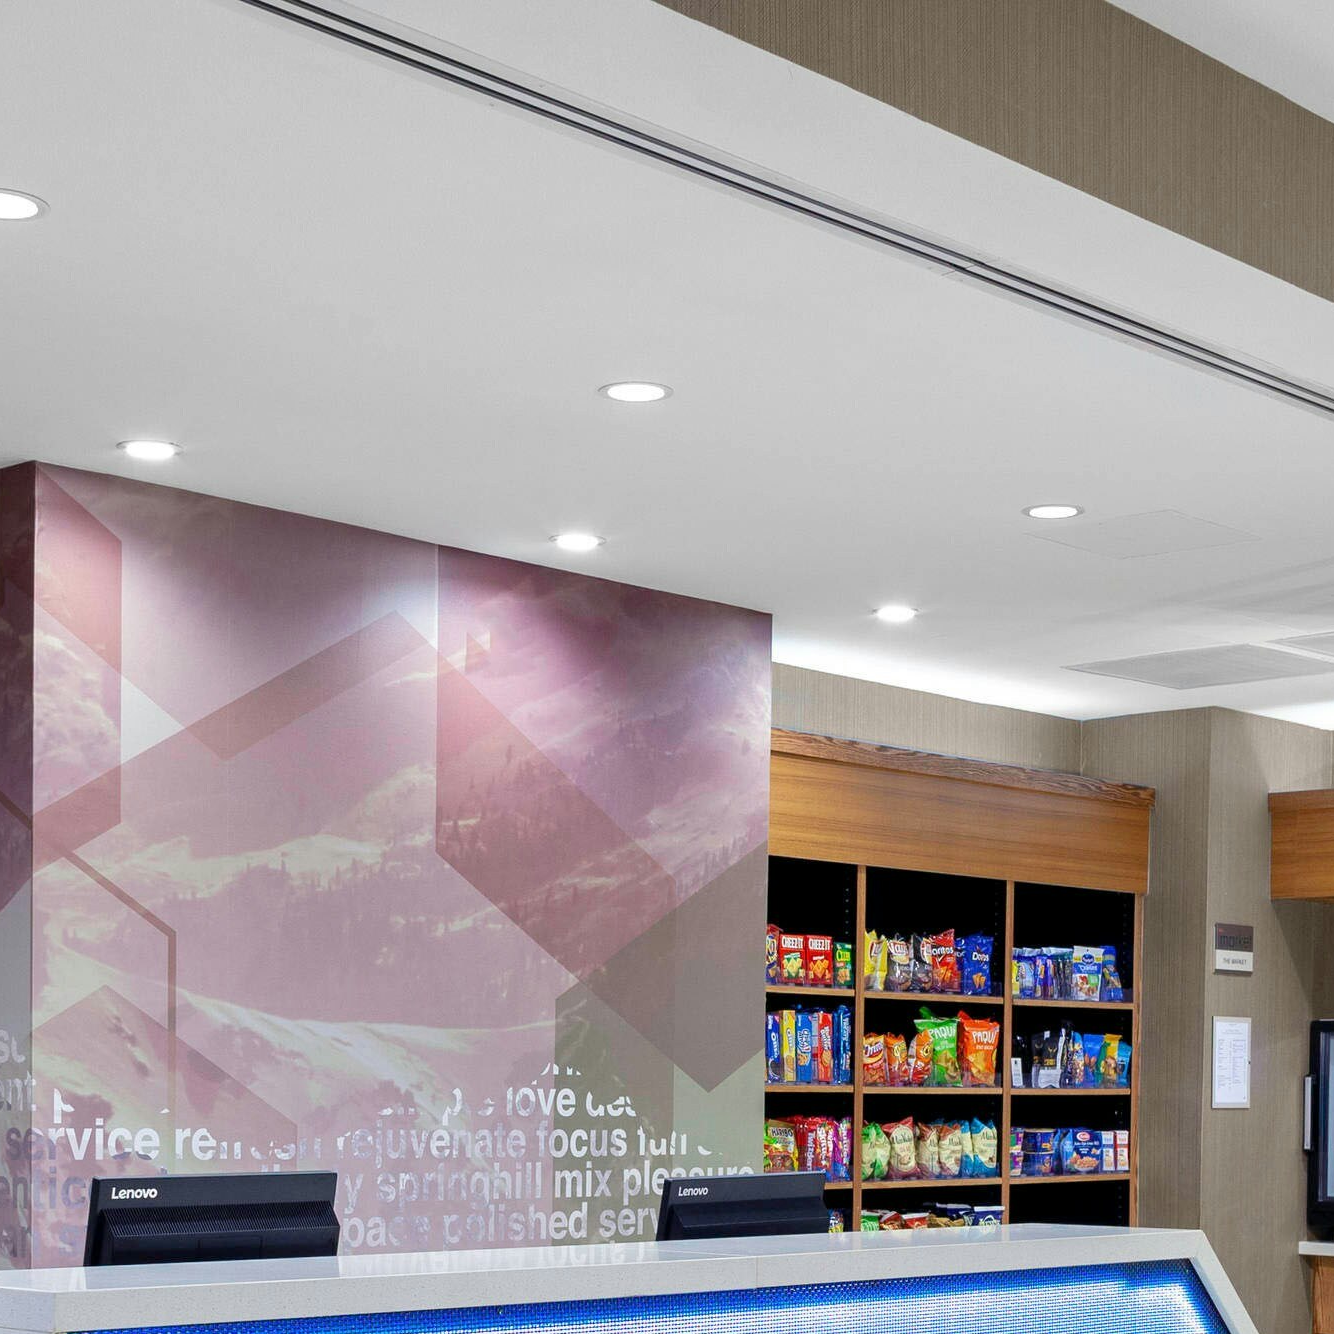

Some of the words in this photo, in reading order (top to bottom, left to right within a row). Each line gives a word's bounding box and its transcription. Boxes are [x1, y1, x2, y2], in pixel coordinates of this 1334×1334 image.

[6, 1117, 161, 1162] service
[536, 1120, 627, 1159] focus
[554, 1160, 612, 1199] mix
[678, 1186, 709, 1198] Lenovo
[111, 1186, 159, 1201] Lenovo
